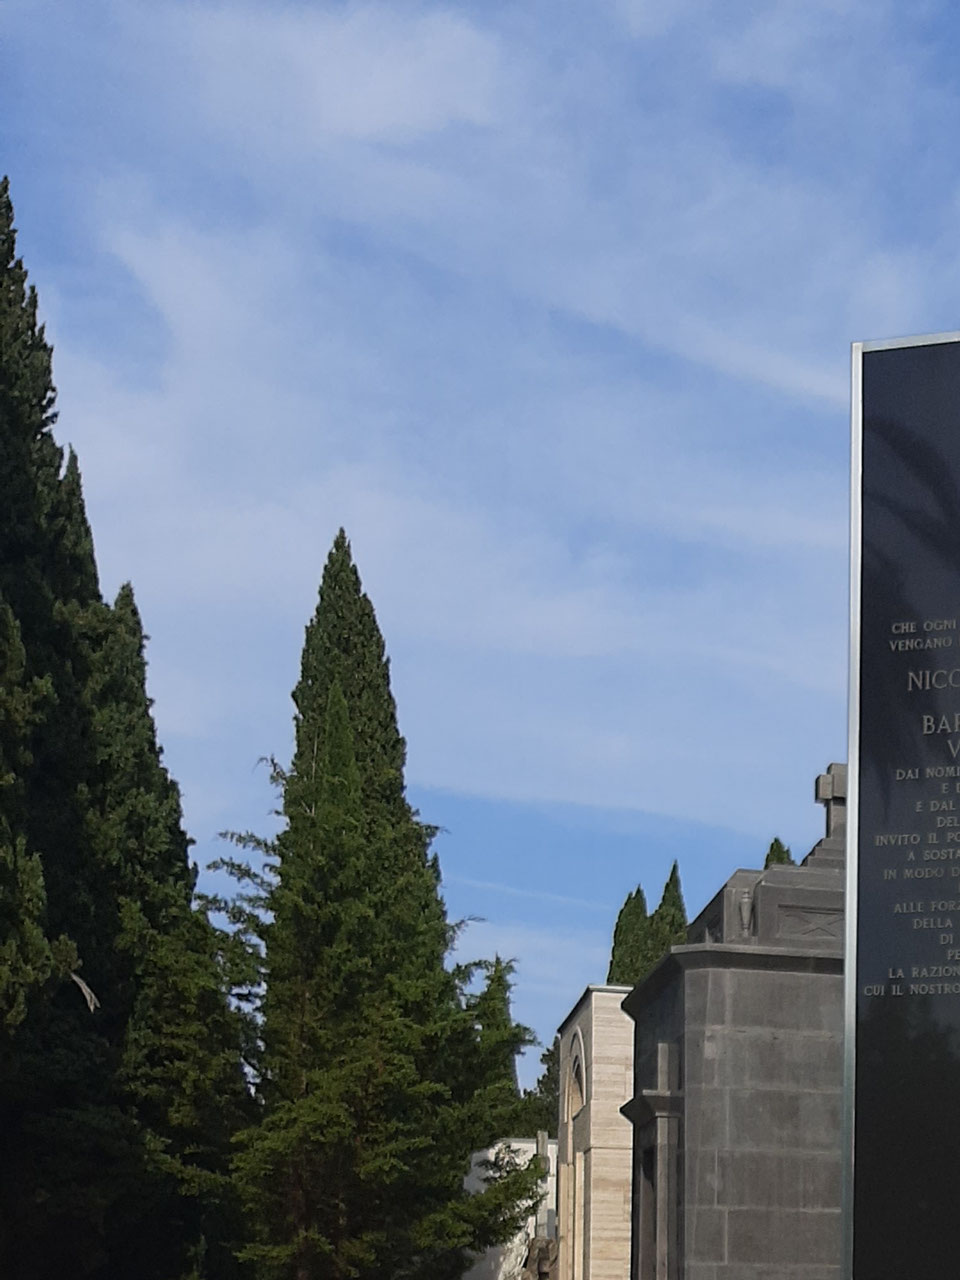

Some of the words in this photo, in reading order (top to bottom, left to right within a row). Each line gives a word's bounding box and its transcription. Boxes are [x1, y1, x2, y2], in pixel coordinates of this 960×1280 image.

[892, 621, 916, 634] CHE
[923, 620, 956, 631] OGNI
[889, 637, 952, 652] VENGANO
[896, 768, 919, 780] DAI
[925, 767, 960, 779] NOMI
[942, 782, 949, 793] E
[915, 800, 923, 812] E
[930, 800, 956, 812] DAL
[937, 816, 960, 827] DEL
[875, 833, 920, 847] INVITO
[928, 833, 939, 844] IL
[908, 851, 915, 861] A
[884, 869, 896, 880] IN
[903, 867, 944, 879] MODO
[894, 902, 923, 913] ALLE
[913, 918, 953, 929] DELLA
[940, 935, 953, 945] DI
[889, 968, 904, 979] LA
[864, 984, 885, 996] CUI
[892, 985, 903, 996] IL
